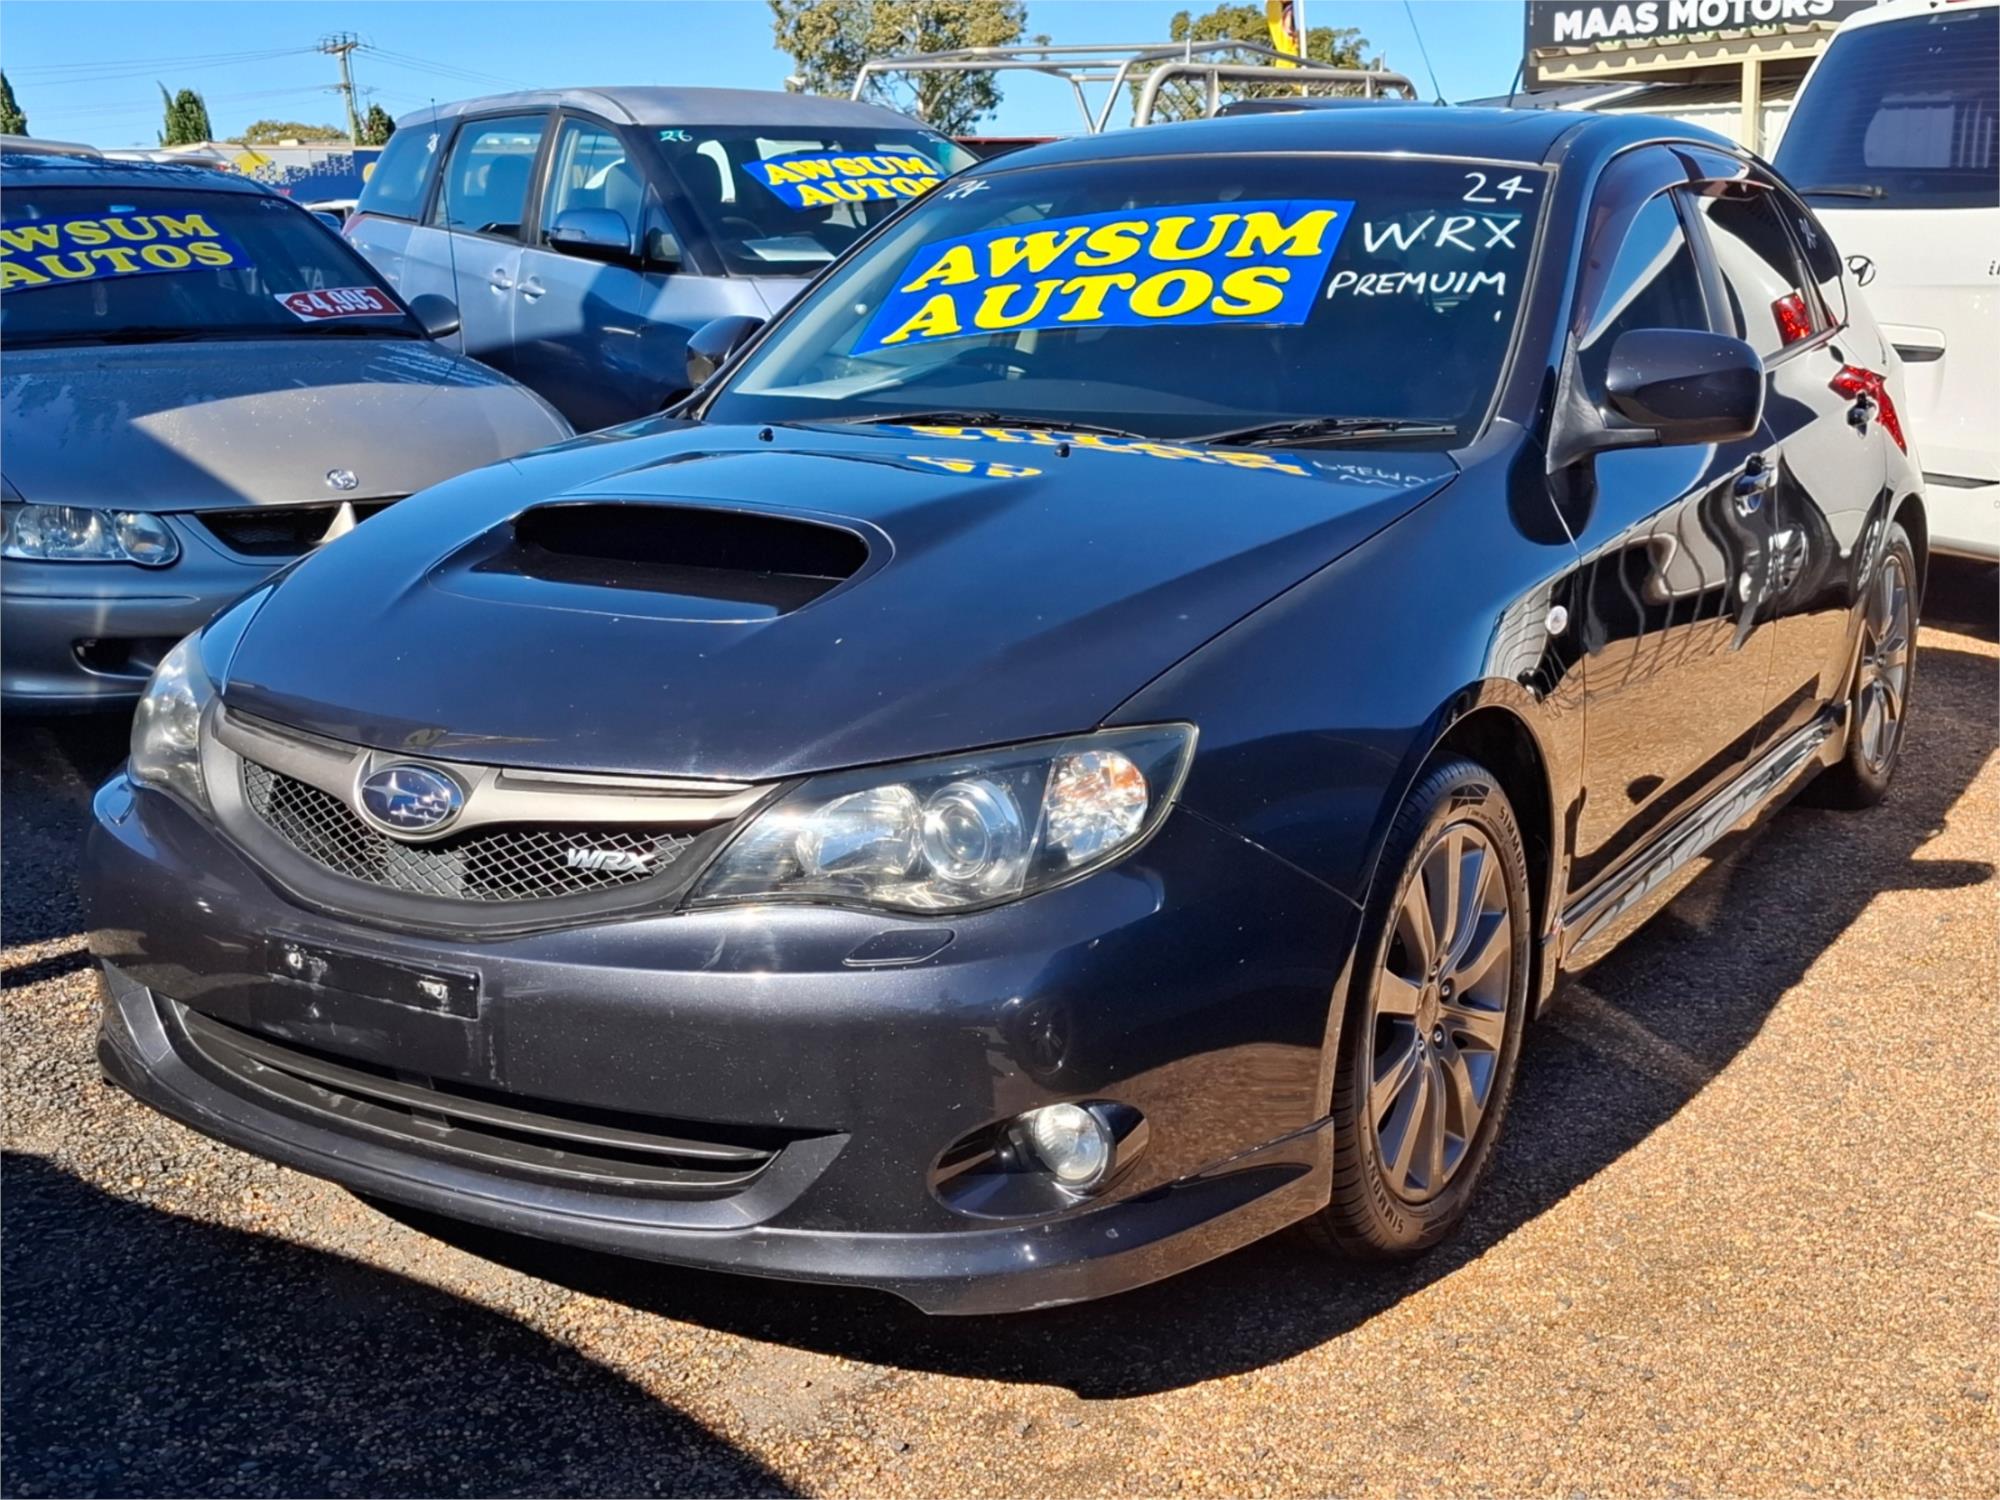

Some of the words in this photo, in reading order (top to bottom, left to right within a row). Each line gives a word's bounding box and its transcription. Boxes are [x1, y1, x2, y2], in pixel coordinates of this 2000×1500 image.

[1554, 5, 1659, 41] MAAS
[660, 129, 693, 142] 26
[764, 156, 938, 186] AWSUM
[1462, 172, 1534, 203] 24
[0, 213, 220, 257] WSUM
[901, 209, 1339, 293] AWSUM
[1363, 215, 1521, 253] WRX
[0, 241, 234, 290] AUTOS
[292, 288, 384, 314] $4,995
[1326, 270, 1506, 300] PREMUIM
[880, 266, 1291, 344] AUTOS
[567, 847, 656, 873] WRX
[1500, 805, 1527, 893] SIMMONS
